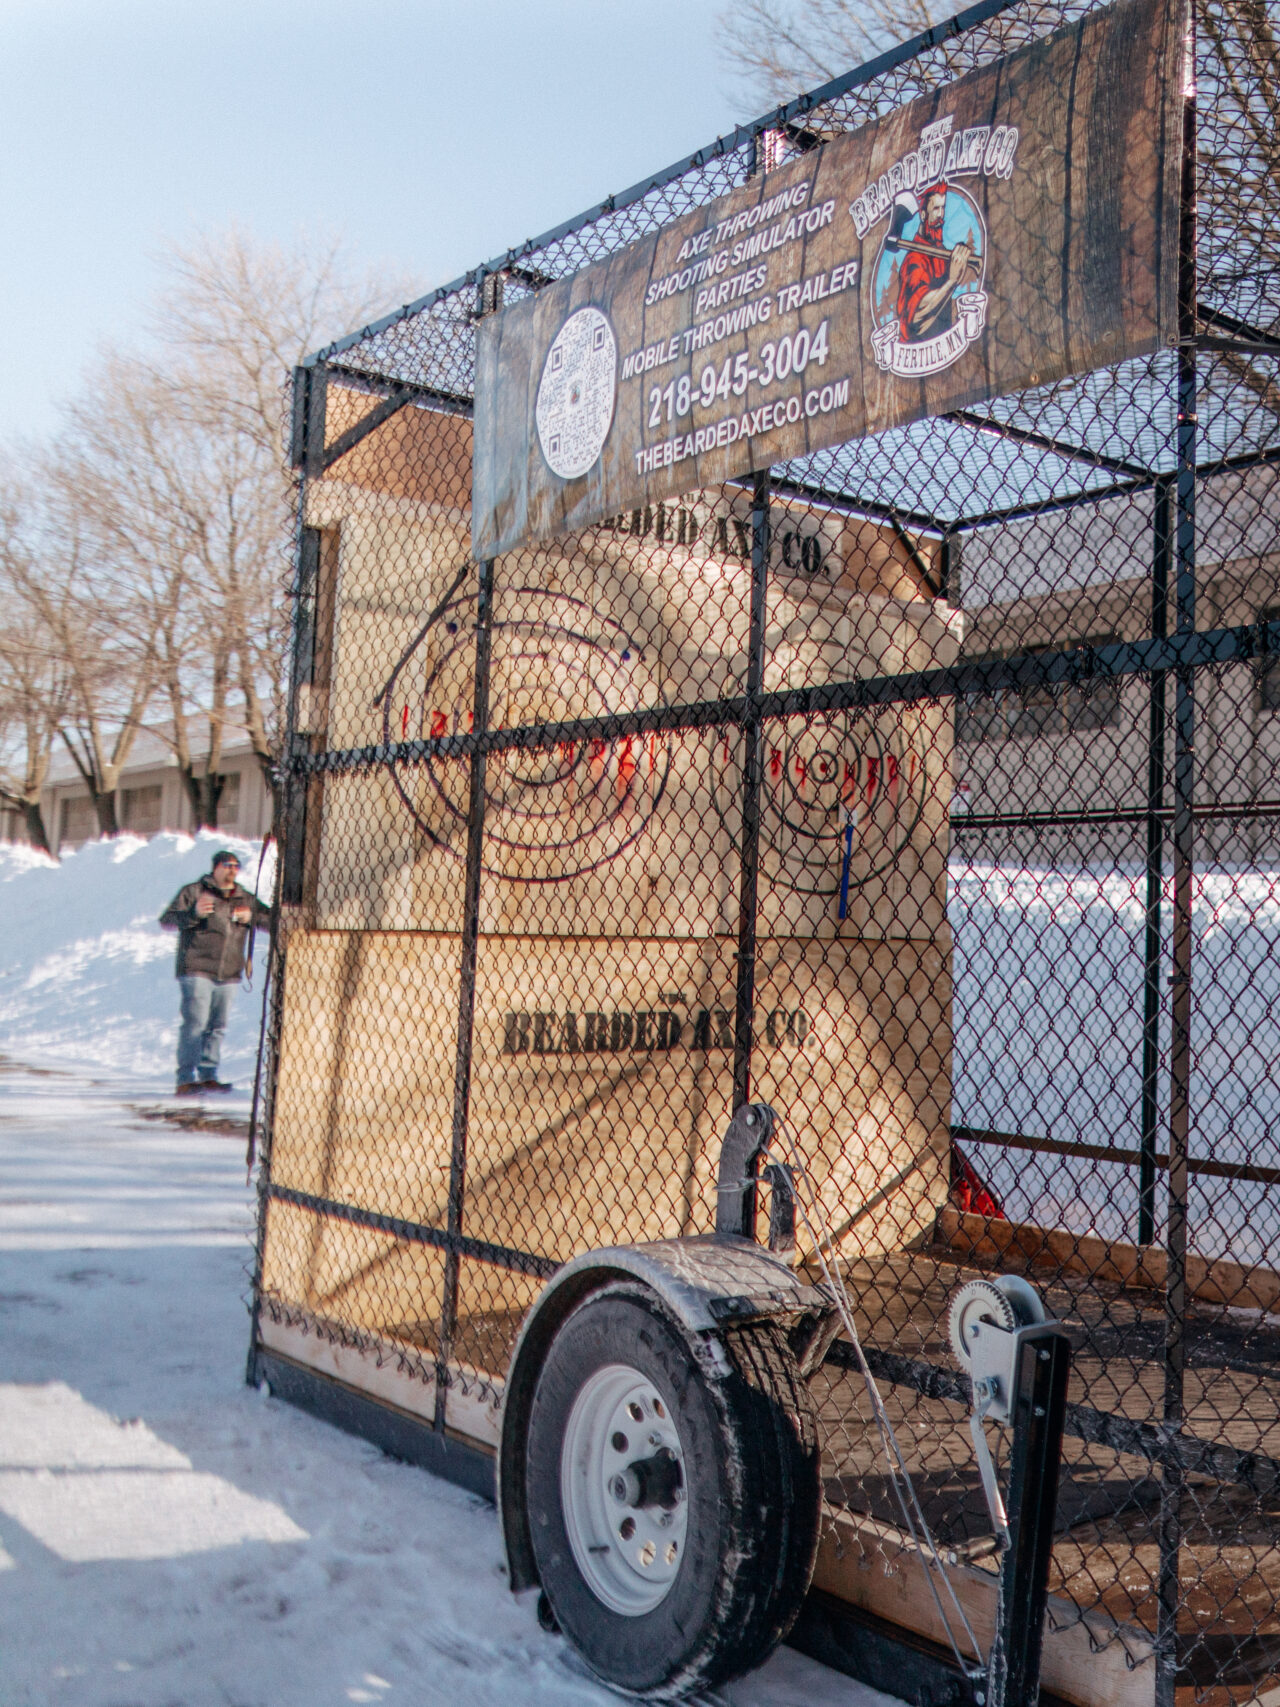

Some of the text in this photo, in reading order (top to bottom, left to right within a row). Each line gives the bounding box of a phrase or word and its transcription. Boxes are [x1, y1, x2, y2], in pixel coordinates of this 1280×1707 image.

[920, 115, 954, 147] THE
[676, 182, 809, 263] AXE THROWING
[849, 138, 946, 240] BEARDED
[945, 126, 991, 178] AXE
[645, 200, 835, 305] SHOOTING SIMULATOR
[695, 264, 767, 315] PARTIES
[621, 261, 858, 380] MOBILE THROWING TRAILER
[649, 321, 829, 428] 218-945-3004
[636, 379, 849, 476] THEBEARDEDAXECO.COM
[502, 1011, 683, 1054] BEARDED
[766, 1009, 816, 1049] CO.
